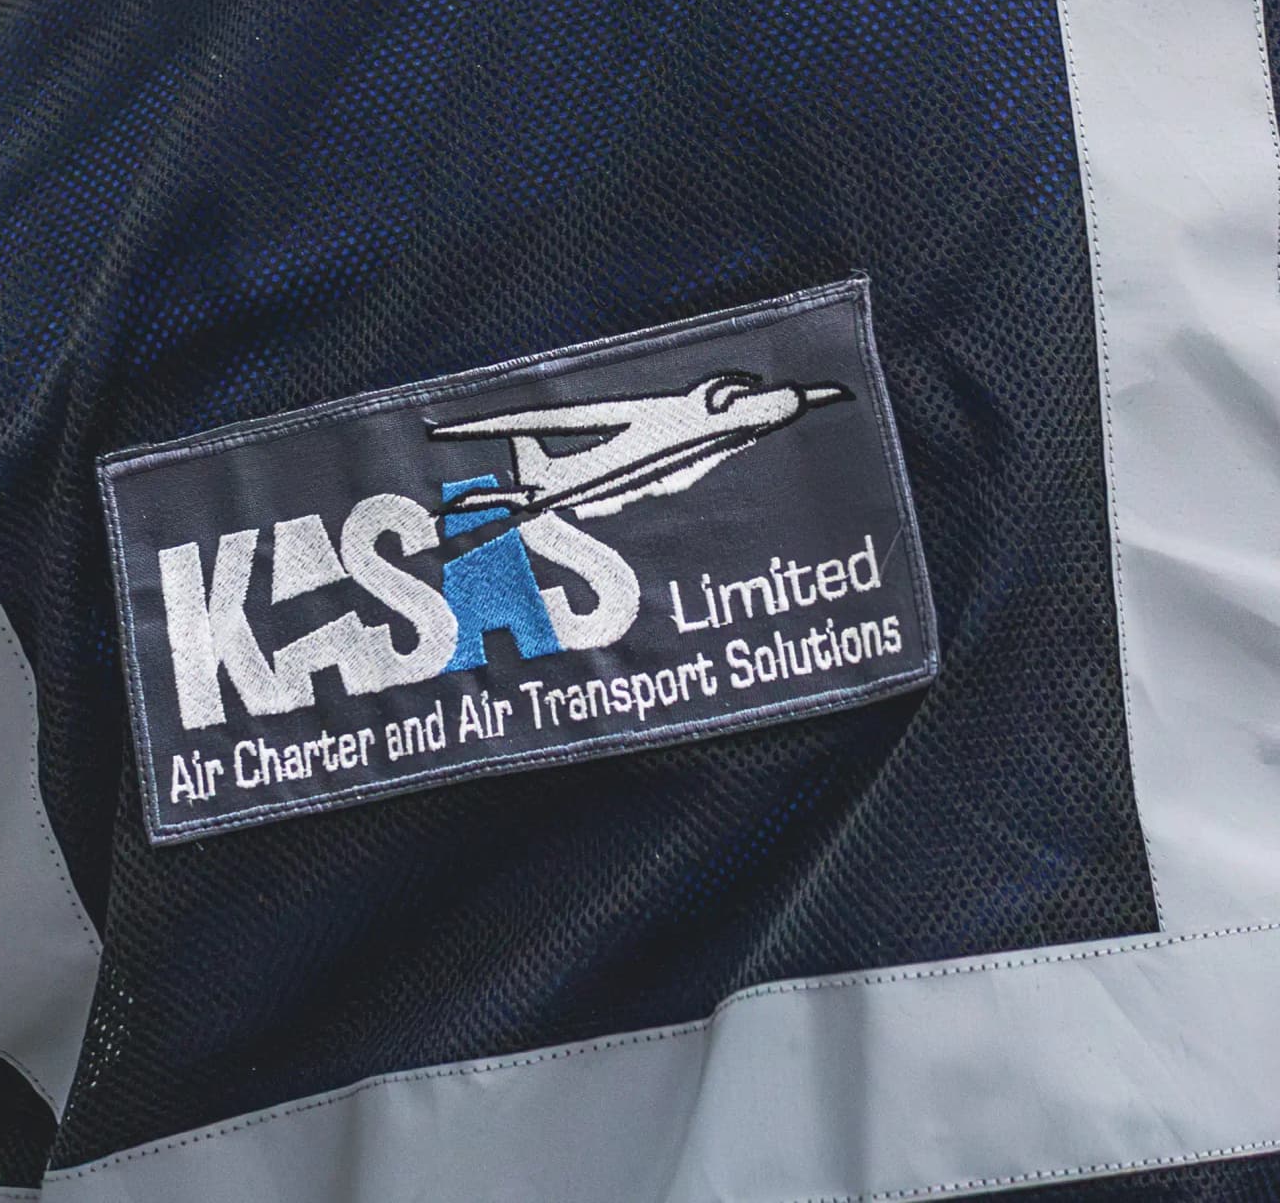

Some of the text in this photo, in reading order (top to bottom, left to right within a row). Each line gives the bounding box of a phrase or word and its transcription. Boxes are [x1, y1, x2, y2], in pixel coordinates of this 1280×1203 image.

[158, 474, 642, 731] KASAS
[670, 534, 882, 634] Limited
[170, 614, 902, 805] Air Charter and Air Transport Solutions
